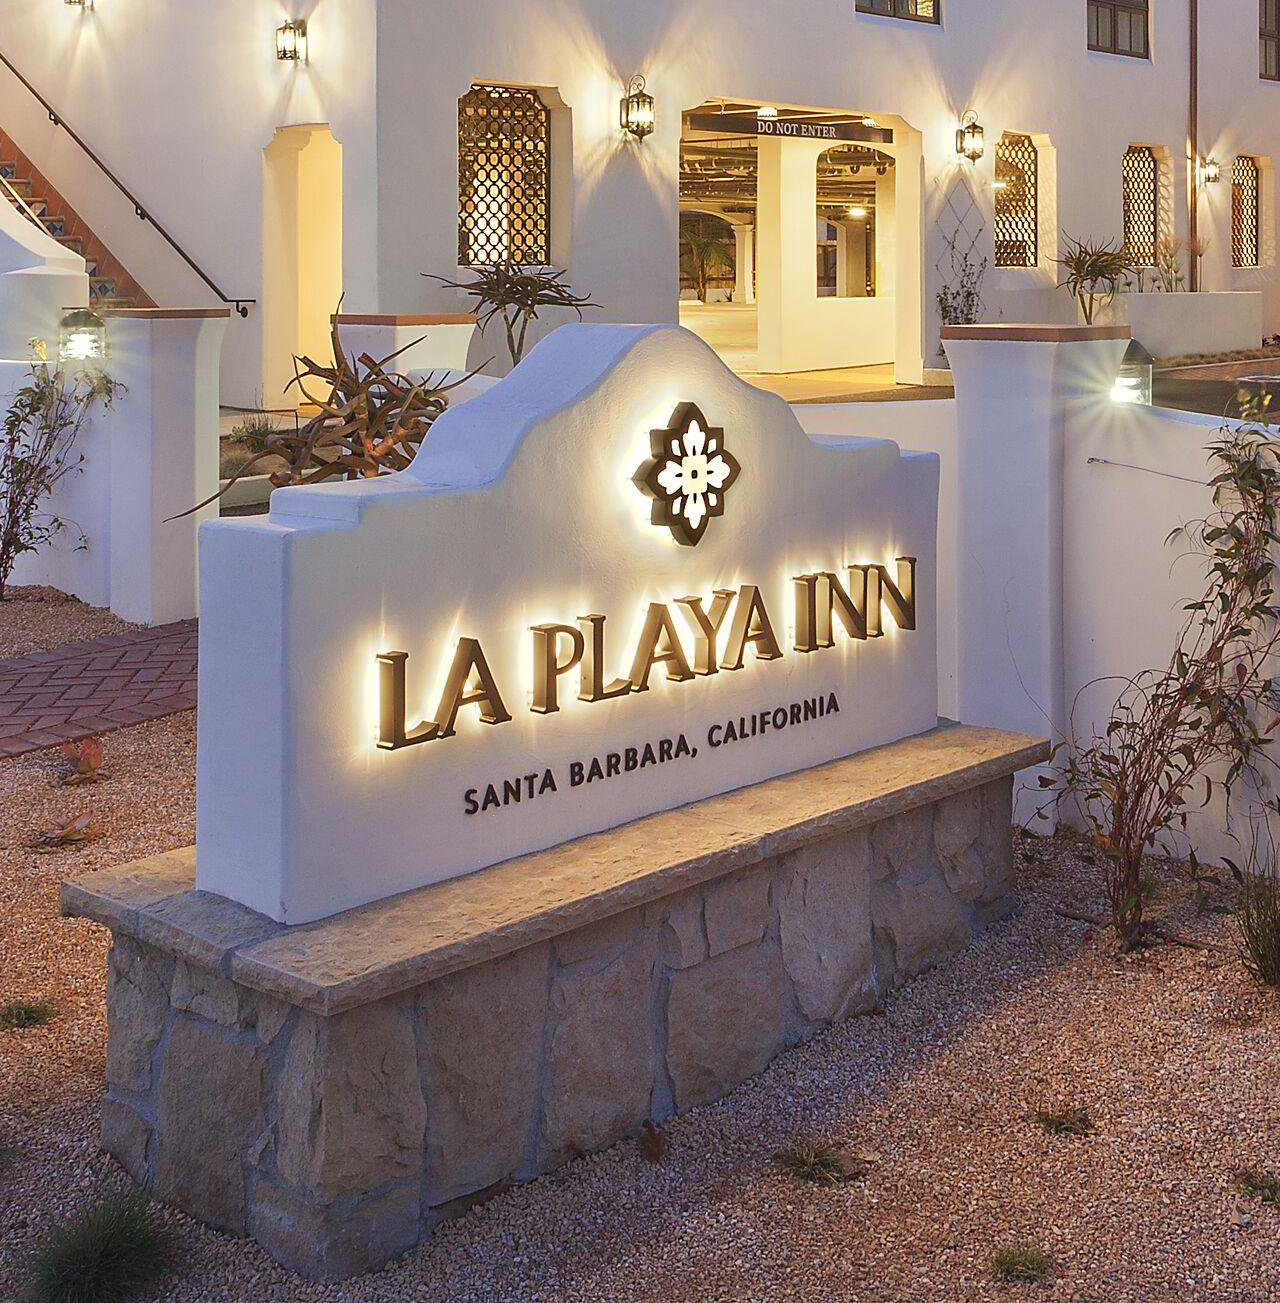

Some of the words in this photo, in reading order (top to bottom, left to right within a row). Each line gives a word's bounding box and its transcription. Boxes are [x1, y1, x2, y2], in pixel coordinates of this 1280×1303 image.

[757, 121, 773, 133] DO
[776, 122, 798, 135] NOT
[801, 124, 837, 138] ENTER
[376, 637, 513, 751] LA
[530, 584, 784, 714] PLAYA
[792, 556, 917, 653] INN
[464, 769, 558, 815] SANTA
[569, 734, 699, 787] BARBARA,
[707, 692, 840, 747] CALIFORNIA
